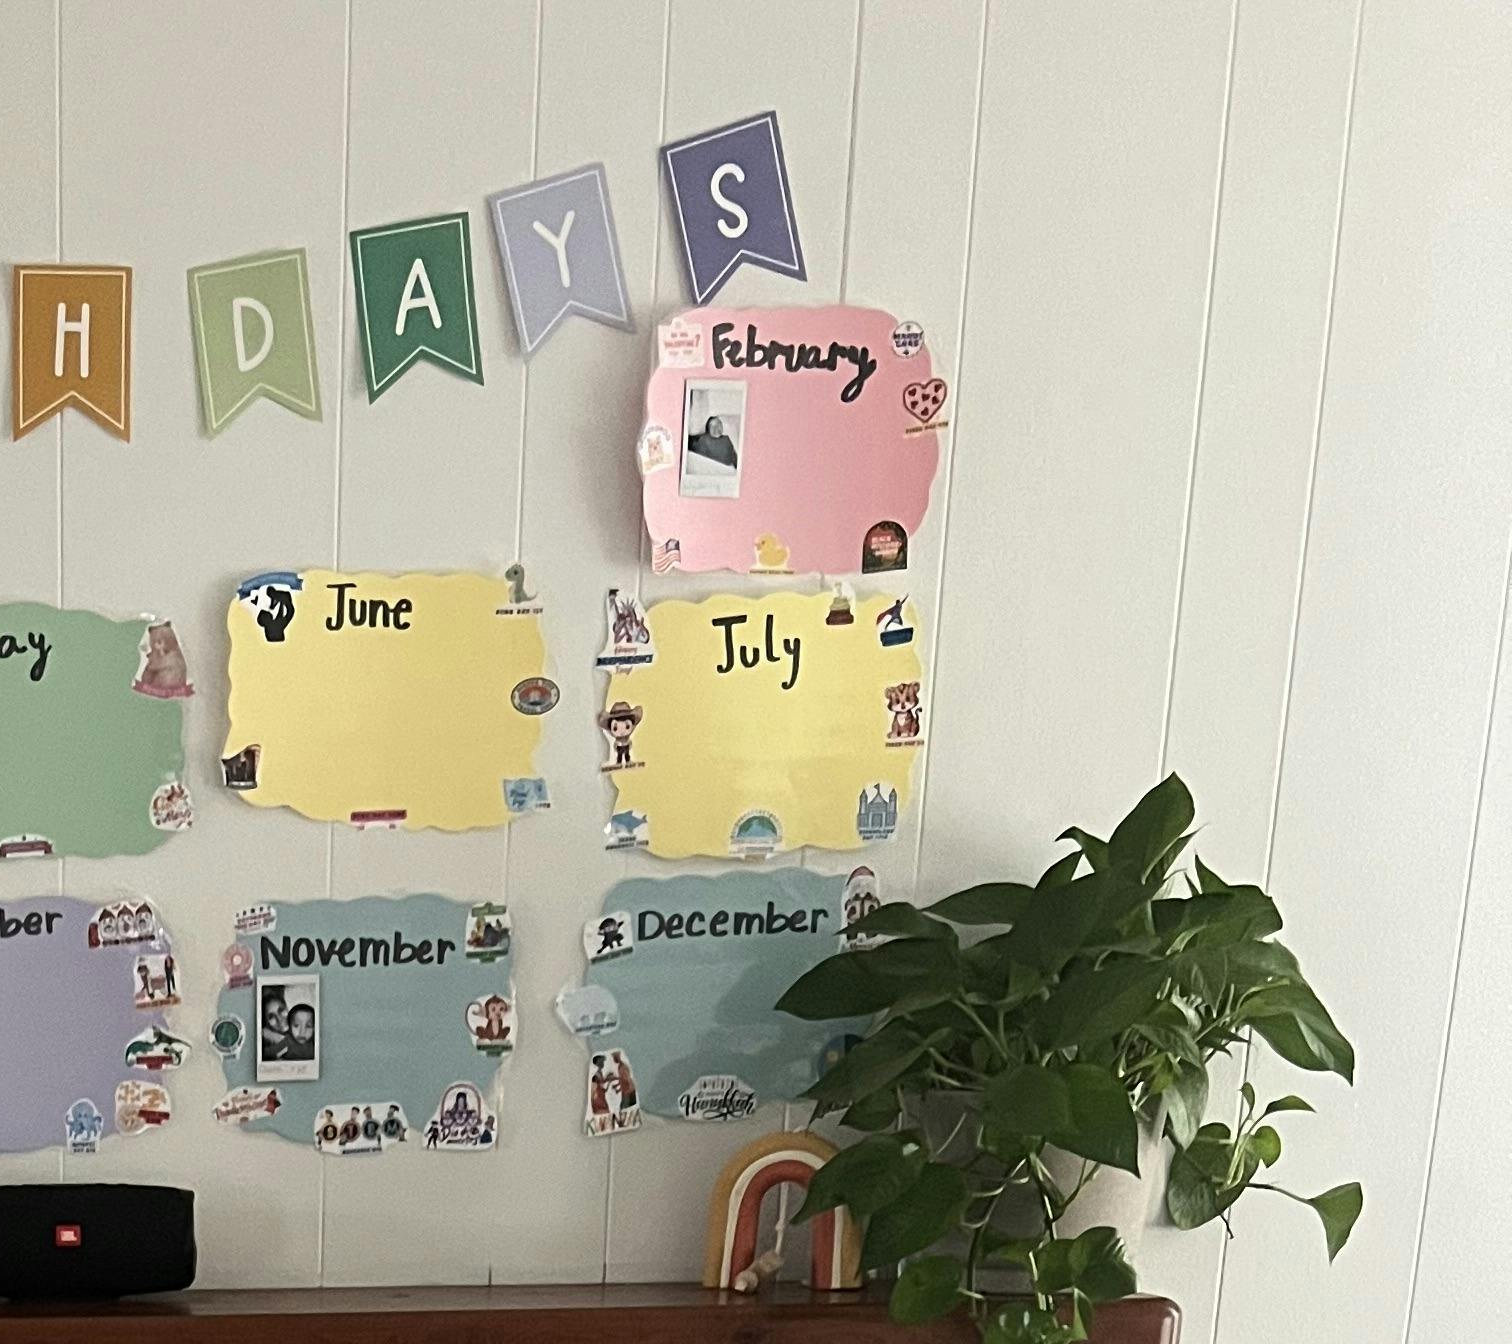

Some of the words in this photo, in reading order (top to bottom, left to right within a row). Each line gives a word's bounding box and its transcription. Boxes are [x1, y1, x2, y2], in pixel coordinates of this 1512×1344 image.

[712, 322, 877, 403] February
[326, 583, 413, 631] June
[712, 615, 801, 690] July
[638, 901, 829, 942] December
[261, 932, 455, 970] November
